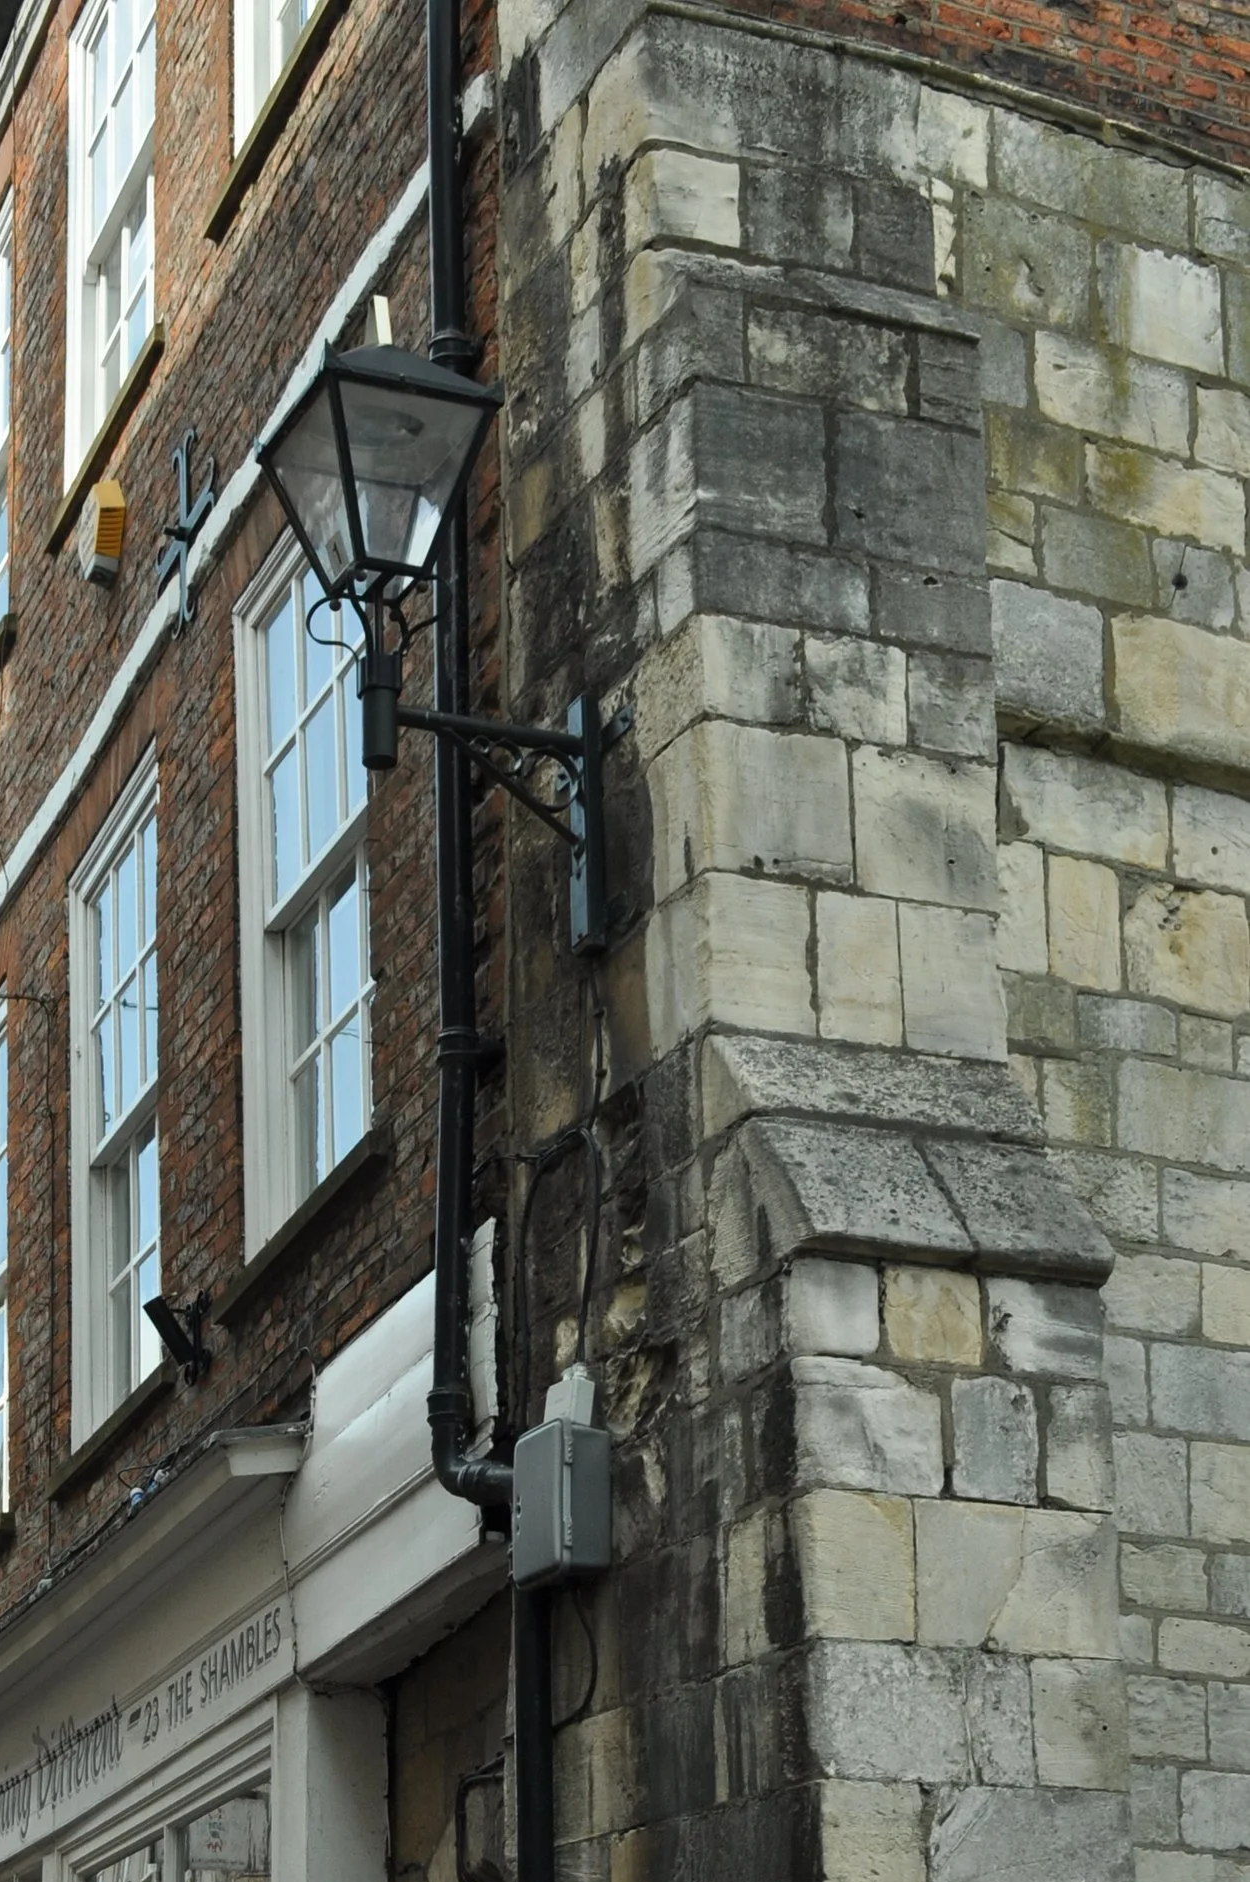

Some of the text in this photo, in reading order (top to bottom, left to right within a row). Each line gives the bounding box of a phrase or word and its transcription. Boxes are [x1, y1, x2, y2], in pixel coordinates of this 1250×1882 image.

[32, 1694, 123, 1810] Different
[143, 1696, 160, 1744] 23
[167, 1670, 193, 1728] THE
[200, 1607, 282, 1704] SHAMBLES
